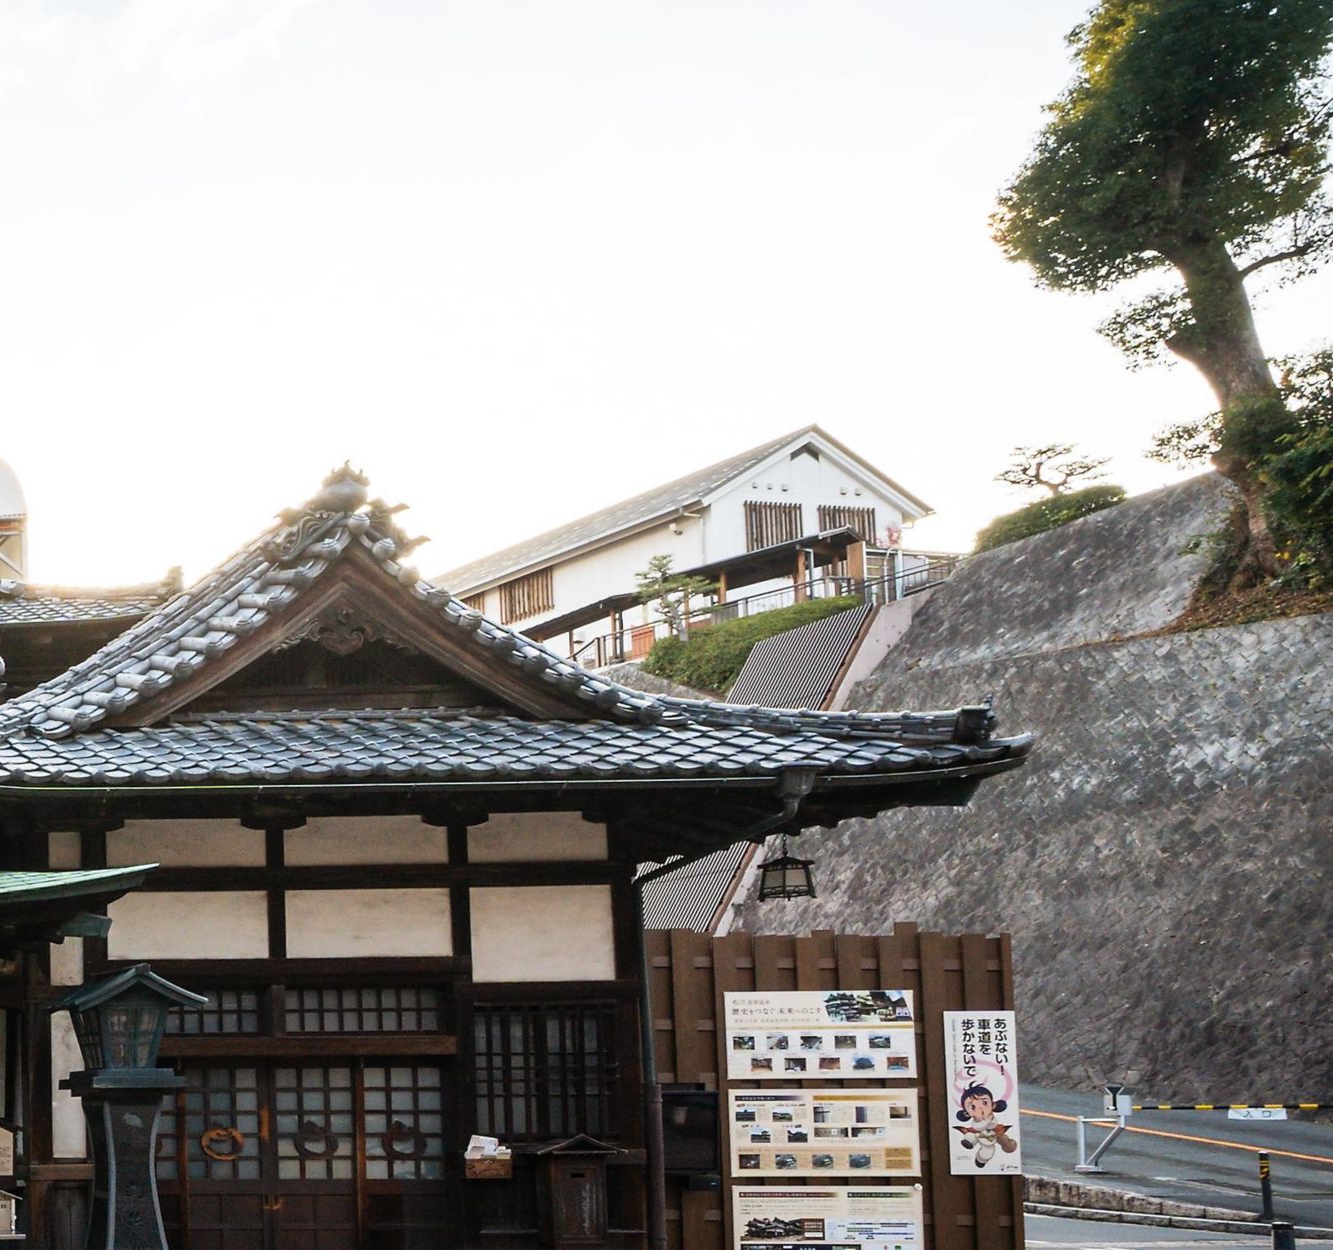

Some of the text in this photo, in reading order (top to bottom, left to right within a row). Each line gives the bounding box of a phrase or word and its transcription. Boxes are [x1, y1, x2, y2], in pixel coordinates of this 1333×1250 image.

[961, 1018, 977, 1077] 歩かないで
[977, 1018, 992, 1056] 車道を
[1243, 1110, 1272, 1119] 入口
